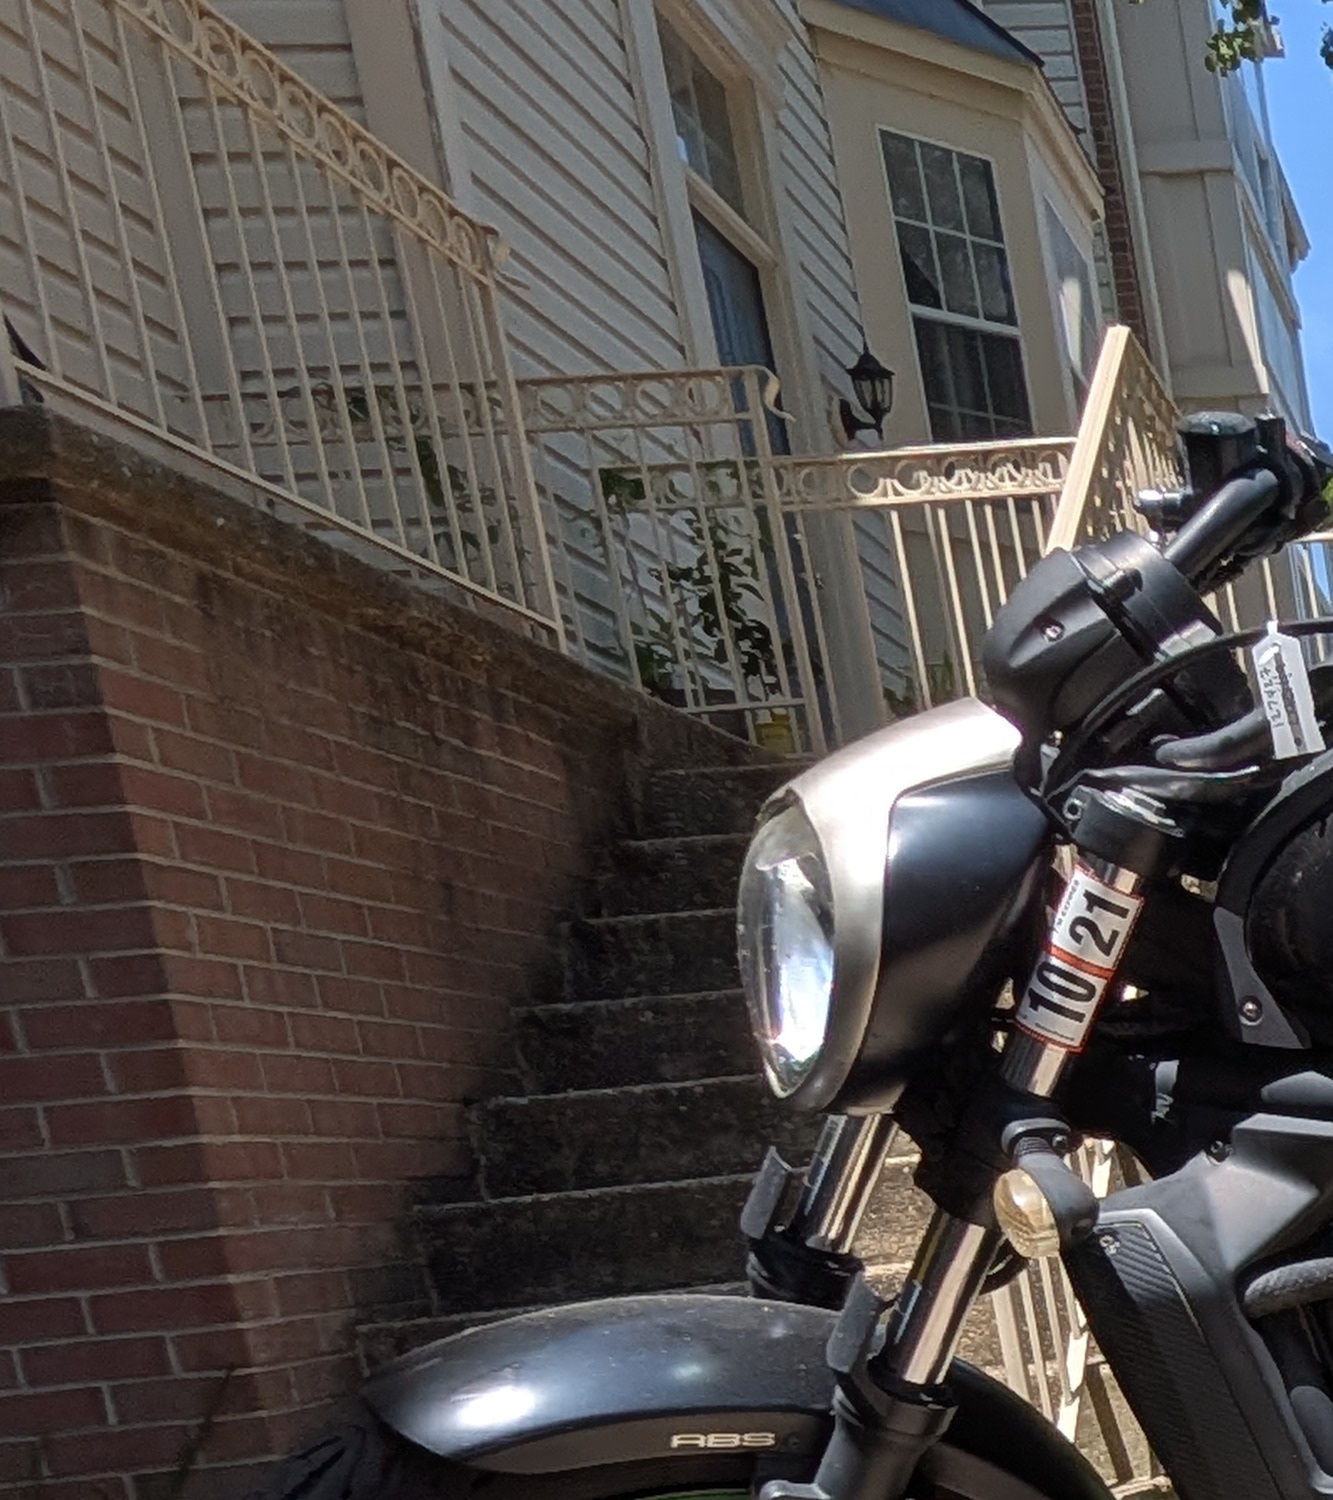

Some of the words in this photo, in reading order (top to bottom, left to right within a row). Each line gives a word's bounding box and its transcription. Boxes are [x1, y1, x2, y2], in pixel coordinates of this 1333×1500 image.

[1028, 961, 1096, 1024] 10
[1069, 889, 1130, 957] 21
[670, 1432, 776, 1448] ABS
